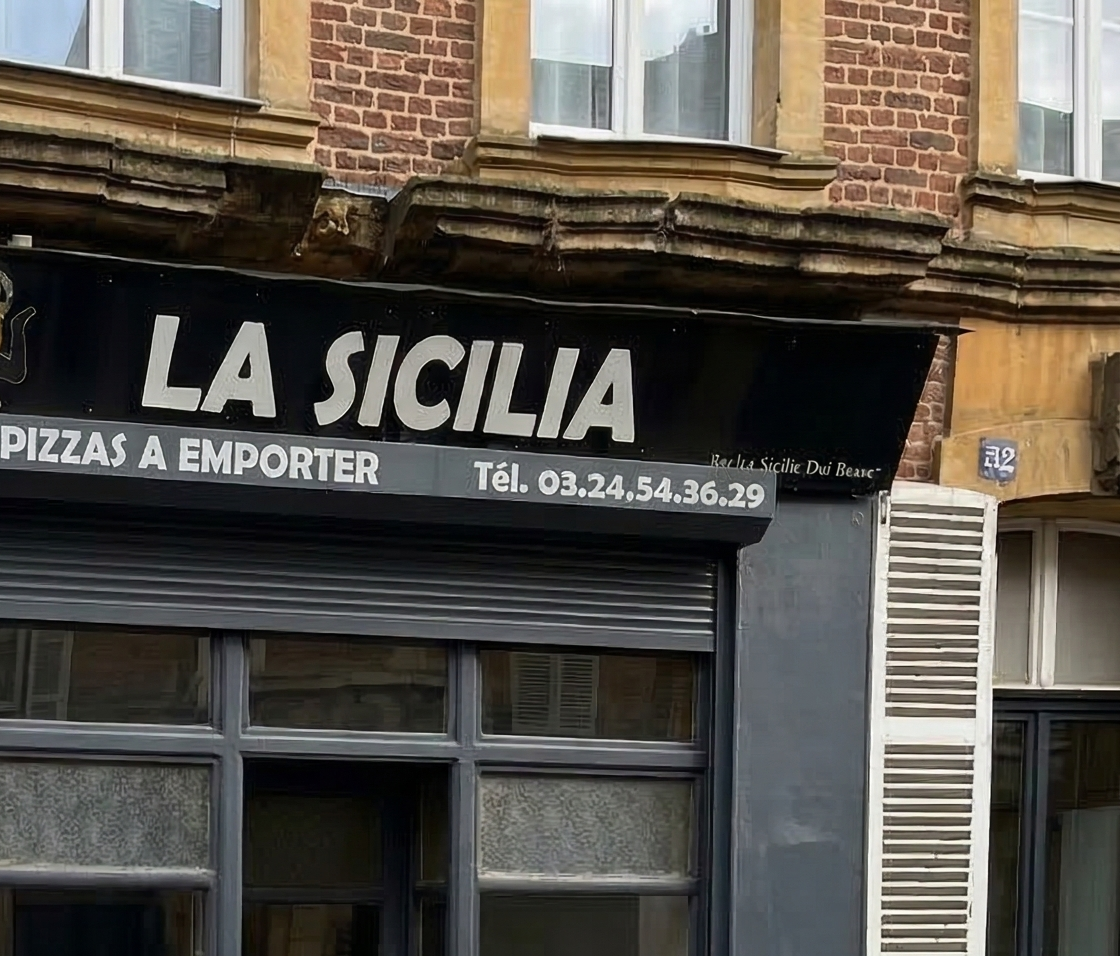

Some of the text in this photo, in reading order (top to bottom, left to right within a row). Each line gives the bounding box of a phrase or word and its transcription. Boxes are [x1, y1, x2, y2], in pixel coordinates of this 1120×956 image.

[141, 314, 635, 443] LA SICILIA
[0, 424, 380, 487] PIZZAS A EMPORTER
[473, 459, 766, 509] Tél. 03.24.54.36.29
